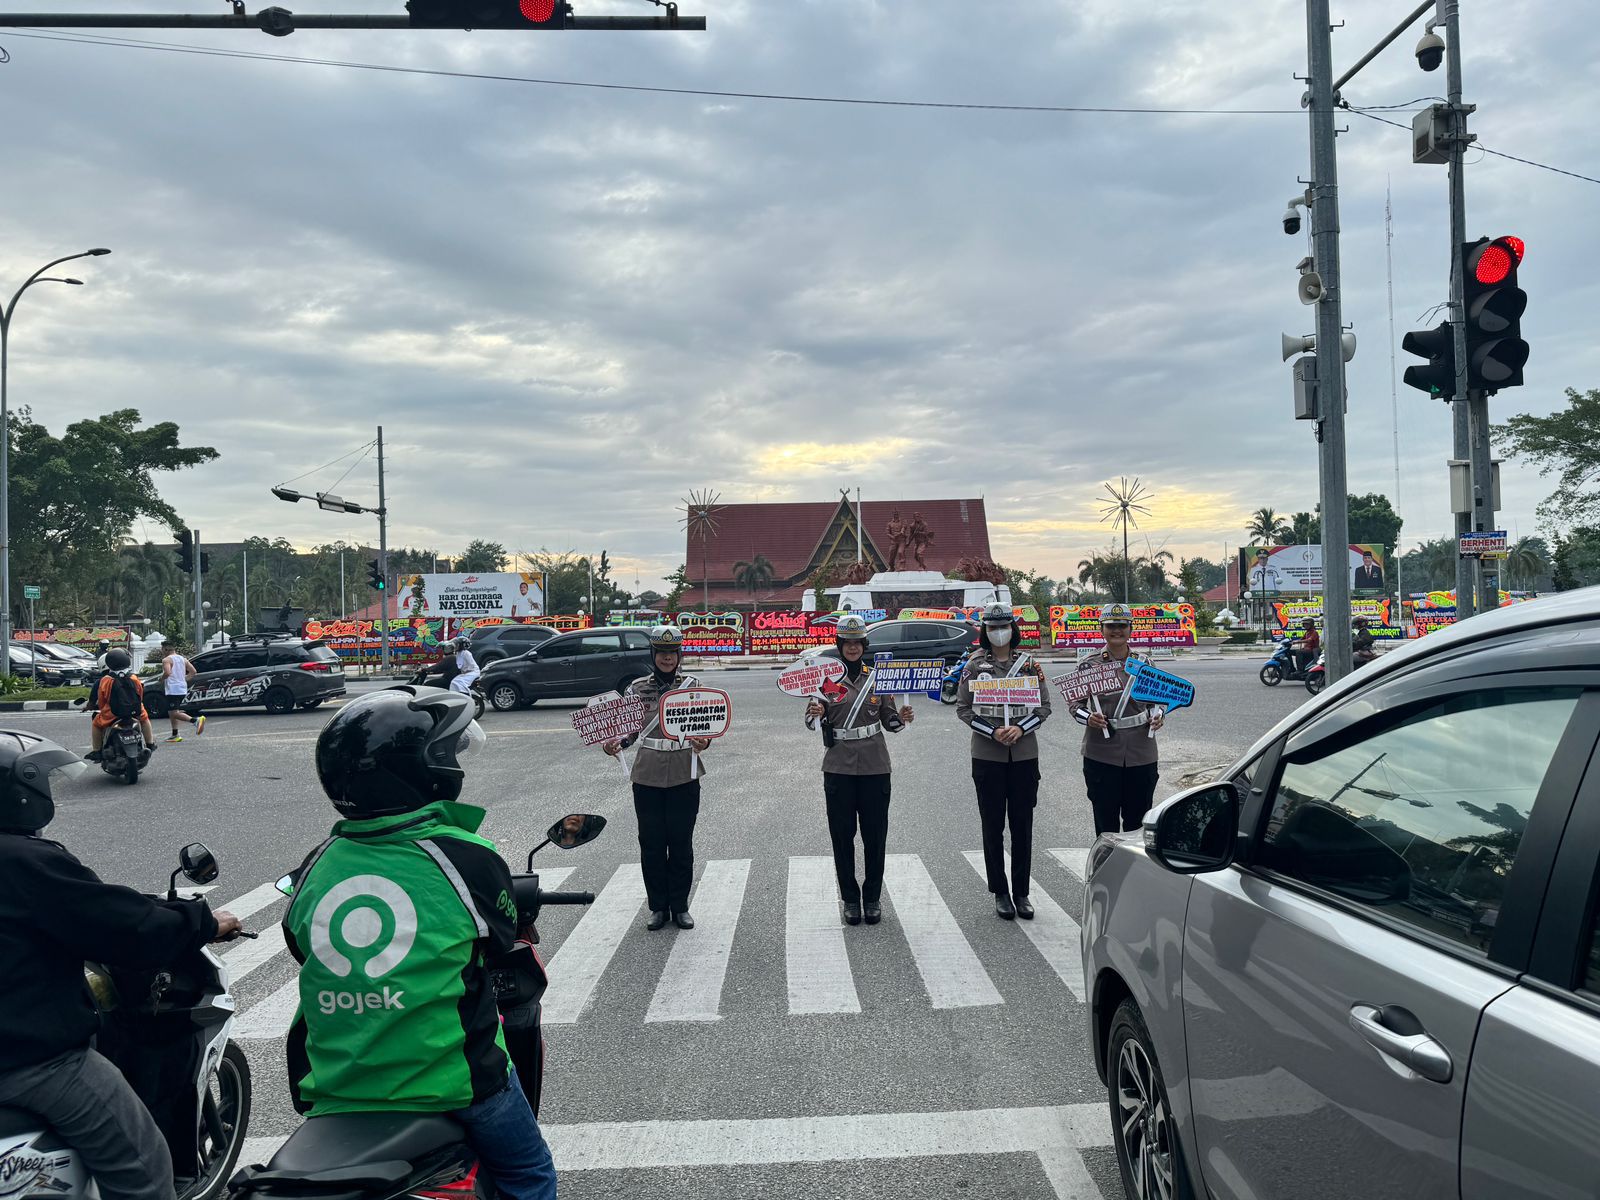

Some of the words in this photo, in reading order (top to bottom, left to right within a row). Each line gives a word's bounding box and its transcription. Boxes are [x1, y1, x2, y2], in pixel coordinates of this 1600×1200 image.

[1461, 538, 1505, 547] BERHENTI
[438, 600, 503, 610] NASIONAL
[682, 618, 740, 626] SUKSES
[754, 611, 808, 629] Selamat
[778, 670, 822, 686] MASYARAKAT
[824, 666, 844, 676] BIJAK
[876, 668, 911, 680] BUDAYA
[912, 668, 940, 679] TERTIB
[1078, 666, 1102, 677] KAMPANYE
[784, 682, 800, 691] TERTIB
[800, 679, 820, 688] BERLALU
[876, 680, 912, 691] BERLALU
[912, 679, 941, 690] LINTAS
[970, 680, 998, 692] JANGAN
[1061, 673, 1103, 690] KESELAMATAN
[1104, 670, 1116, 680] DIRI
[1137, 674, 1160, 689] TERTIB
[1160, 683, 1168, 692] DI
[1169, 687, 1190, 698] JALAN
[1140, 668, 1156, 678] MAU
[1157, 674, 1192, 692] KAMPANYE
[800, 686, 818, 694] LINTAS
[976, 688, 1009, 697] JANGAN
[1010, 688, 1039, 697] NGEBUT
[1061, 684, 1088, 701] TETAP
[1090, 676, 1122, 694] DIJAGA
[570, 708, 591, 720] TERTIB
[592, 700, 618, 714] BERLALU
[618, 695, 640, 706] LINTAS
[666, 705, 726, 716] KESELAMATAN
[572, 716, 595, 728] CERMIN
[595, 709, 618, 721] BUDAYA
[618, 702, 642, 715] BANGSA
[666, 716, 688, 724] TETAP
[688, 714, 726, 724] PRIORITAS
[577, 716, 616, 736] KAMPANYE
[617, 710, 642, 724] TERTIB
[680, 722, 710, 732] UTAMA
[583, 728, 615, 745] BERLALU
[616, 721, 641, 735] LINTAS
[318, 986, 406, 1014] gojek
[2, 1156, 45, 1181] Street
